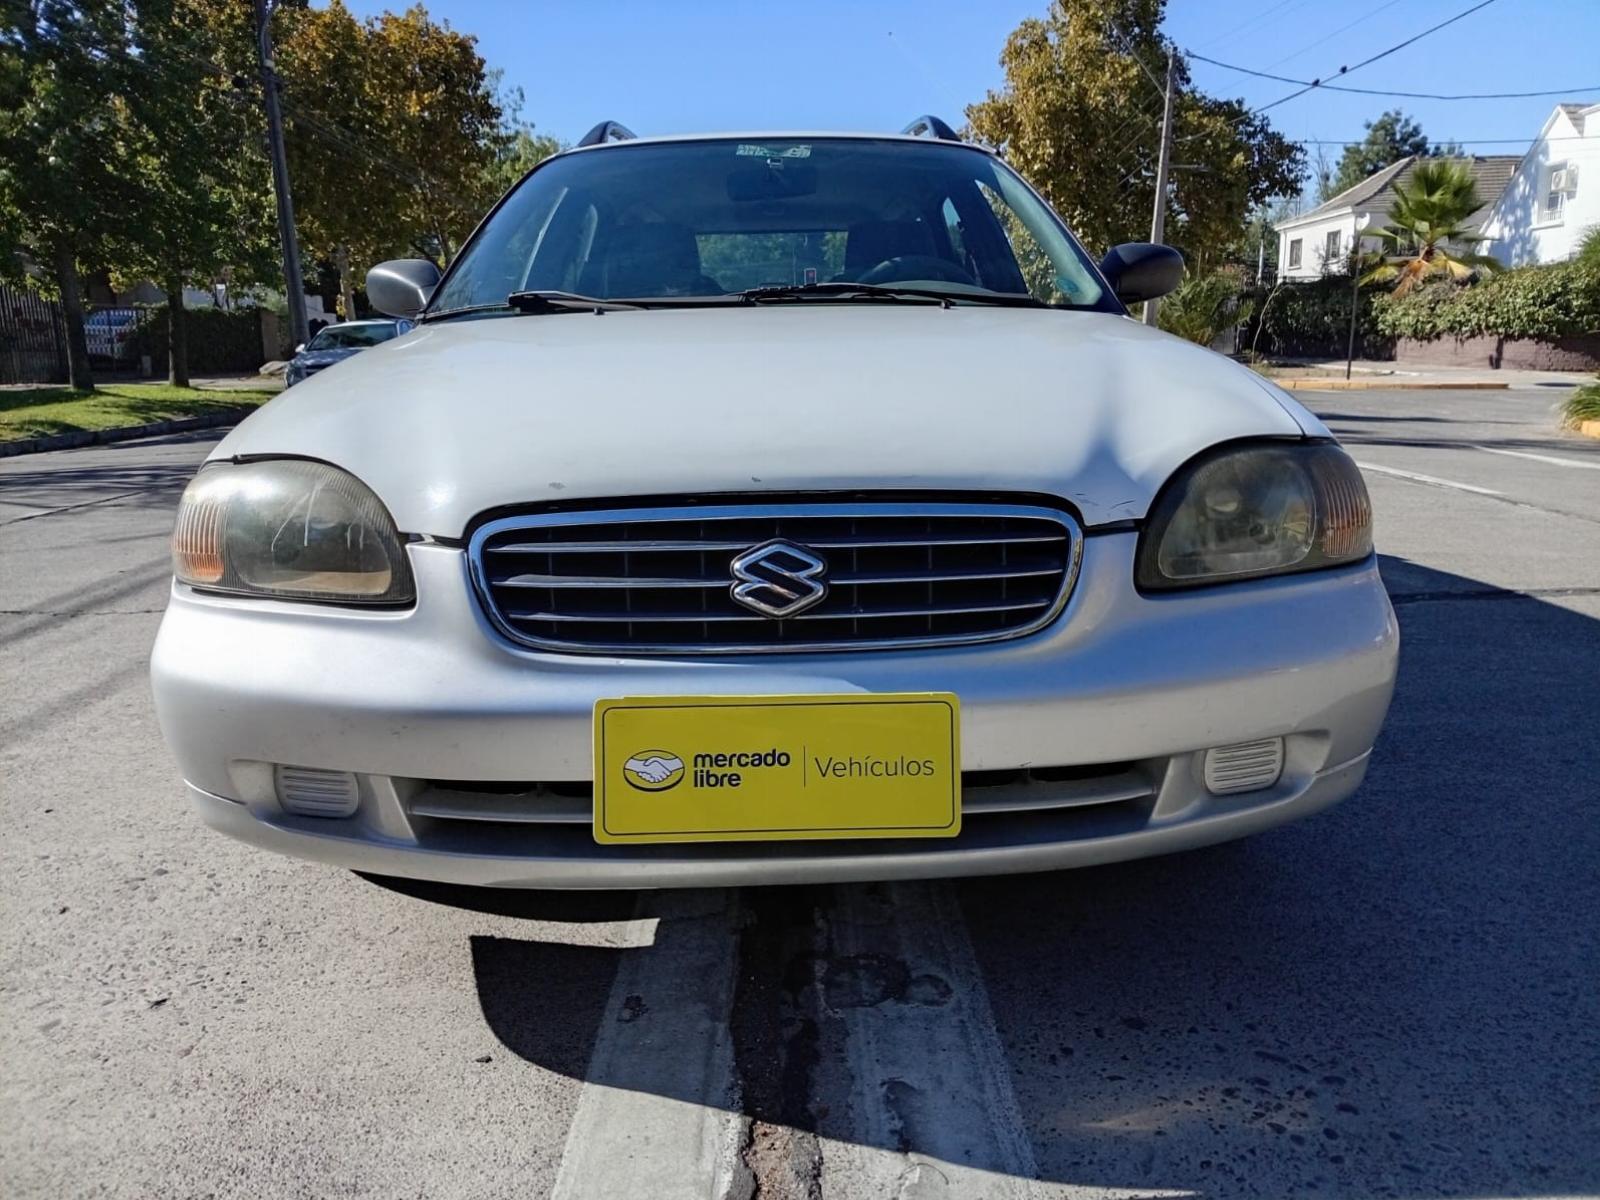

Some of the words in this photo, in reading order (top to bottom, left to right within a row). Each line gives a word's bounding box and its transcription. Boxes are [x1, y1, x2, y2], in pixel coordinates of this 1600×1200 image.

[693, 748, 791, 768] mercado
[814, 755, 935, 778] Vehículos
[693, 769, 742, 788] libre
